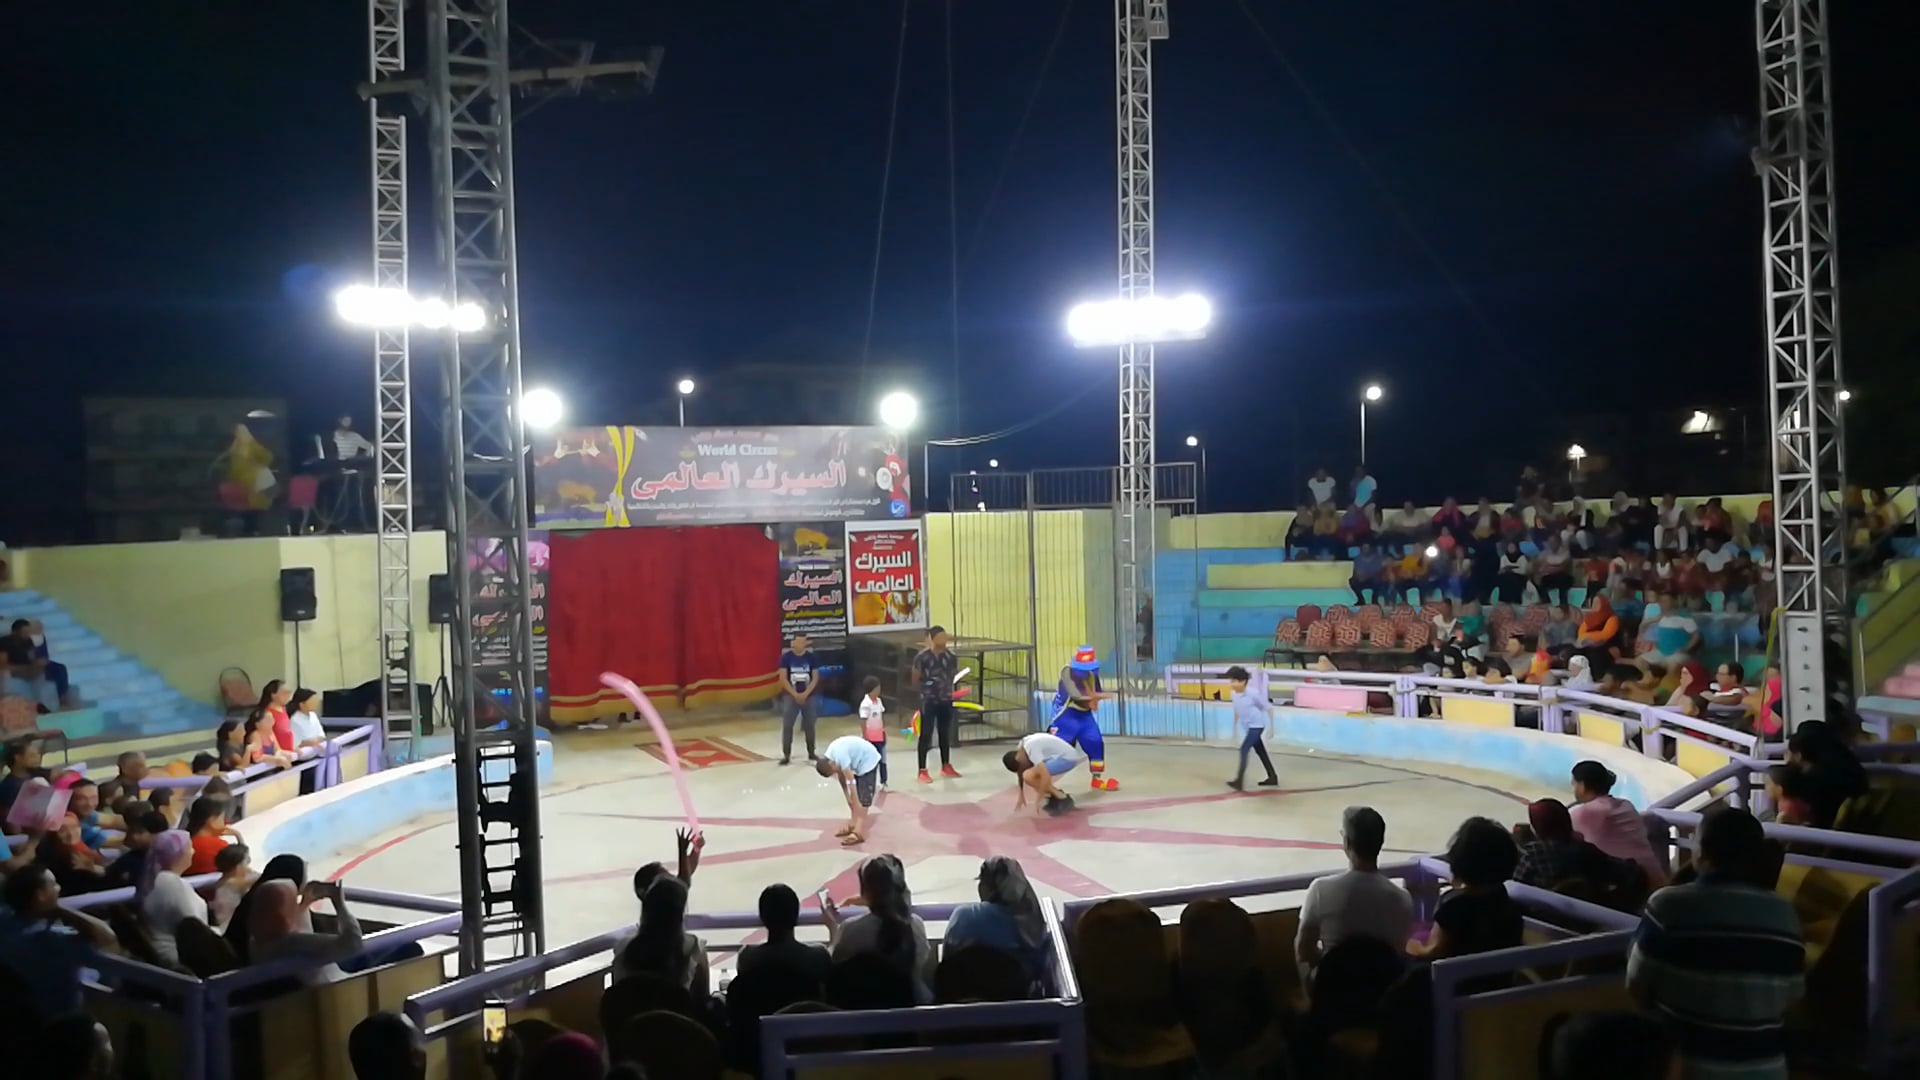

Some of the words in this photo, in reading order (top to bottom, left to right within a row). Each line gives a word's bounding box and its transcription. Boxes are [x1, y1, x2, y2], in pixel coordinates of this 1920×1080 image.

[697, 444, 736, 456] World
[746, 458, 847, 496] السيرك
[855, 551, 912, 573] السيرك
[784, 569, 843, 588] السيرك
